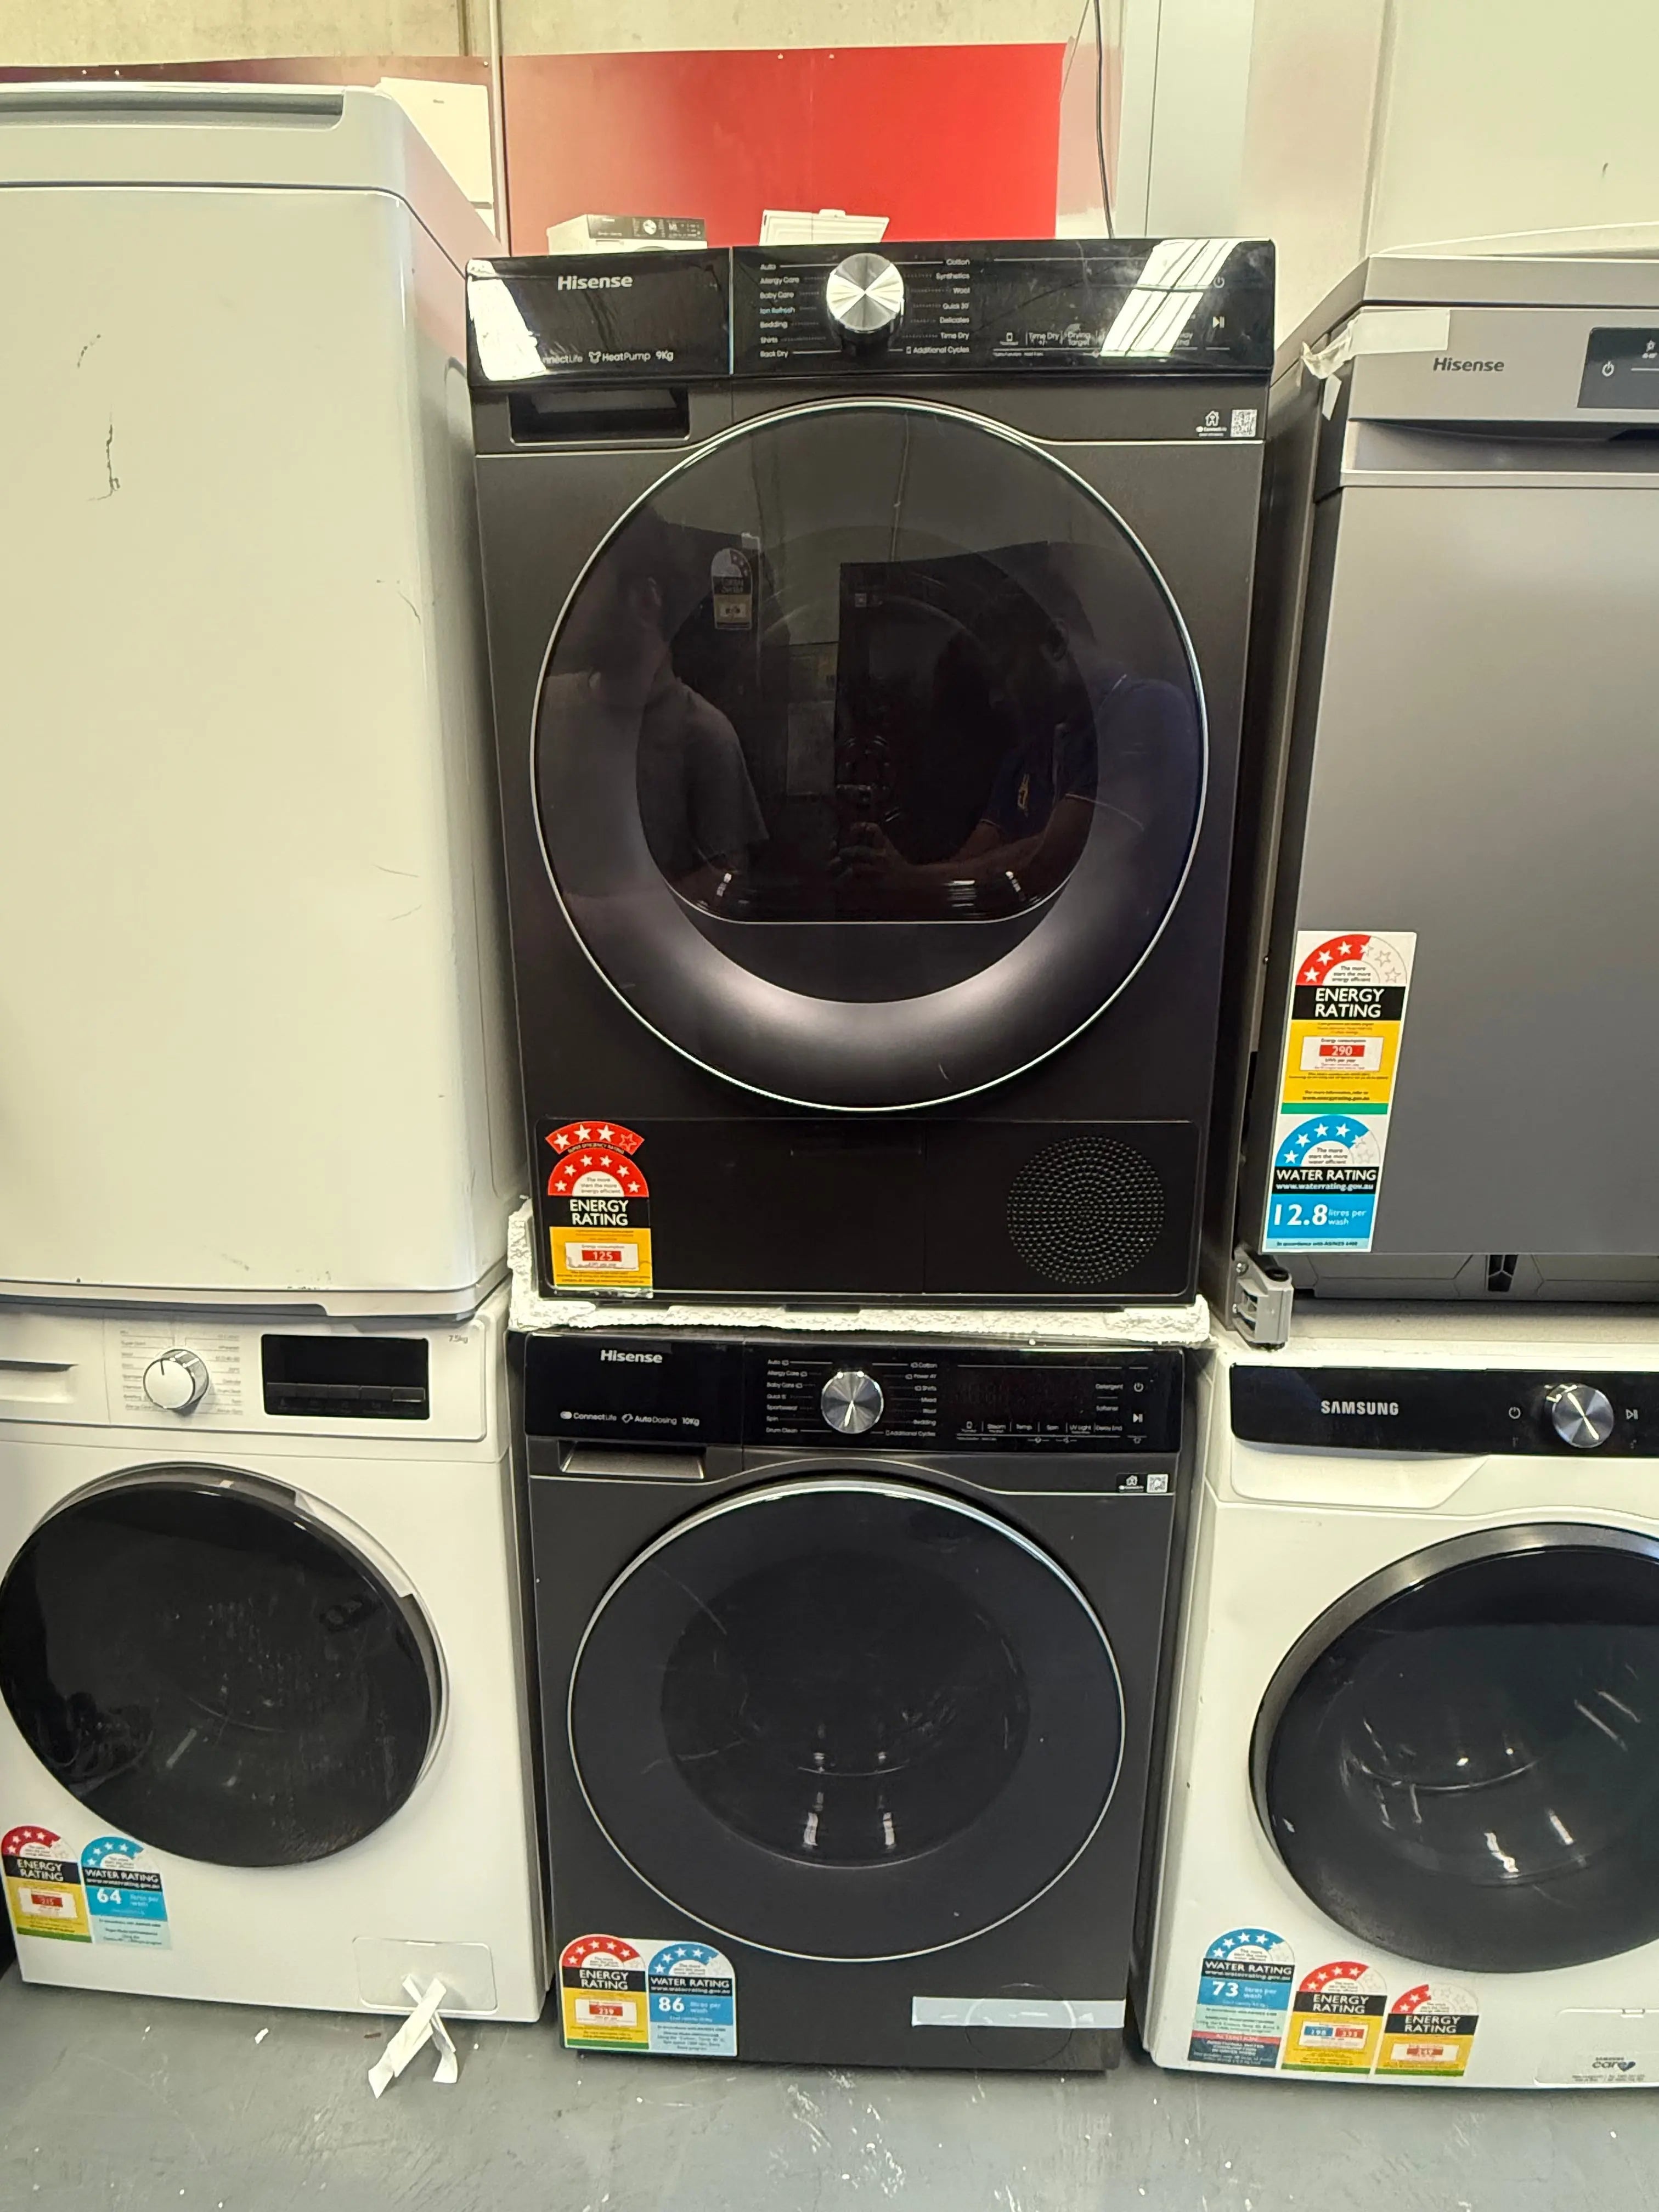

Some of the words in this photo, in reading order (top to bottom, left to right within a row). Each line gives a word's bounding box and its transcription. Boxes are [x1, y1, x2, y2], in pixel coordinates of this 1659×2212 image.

[936, 272, 970, 280] Synthetics
[557, 275, 633, 290] Hisense
[760, 291, 777, 300] Baby
[760, 321, 788, 329] Bedding
[958, 332, 970, 340] Dry
[1047, 332, 1060, 341] Dry
[1068, 332, 1091, 340] Drying
[947, 346, 970, 354] Cycles
[543, 354, 583, 363] nnectLife
[602, 352, 651, 362] HeatPump
[656, 350, 674, 362] 9Kg
[1433, 357, 1504, 372] Hisense
[1315, 988, 1385, 1002] ENERGY
[1314, 1003, 1381, 1018] RATING
[1331, 1046, 1353, 1056] 290
[1276, 1169, 1323, 1181] WATER
[1326, 1170, 1377, 1181] RATING
[1276, 1182, 1374, 1192] www.waterrating.gov.au
[569, 1199, 629, 1212] ENERGY
[1274, 1204, 1328, 1226] 12.8
[1328, 1208, 1350, 1217] litres
[1352, 1210, 1367, 1219] per
[572, 1213, 628, 1226] RATING
[592, 1251, 613, 1261] 125
[600, 1350, 663, 1363] Hisense
[1321, 1400, 1399, 1415] SAMSUNG
[573, 1413, 617, 1421] ConnectLife
[634, 1416, 677, 1425] AutoDosing
[682, 1417, 699, 1426] 10Kg
[17, 1859, 62, 1872] ENERGY
[20, 1869, 64, 1882] RATING
[85, 1869, 120, 1879] WATER
[121, 1872, 159, 1883] RATING
[97, 1887, 122, 1904] 64
[1205, 1961, 1245, 1972] WATER
[1248, 1964, 1292, 1975] RATING
[579, 1970, 629, 1981] ENERGY
[1205, 1970, 1291, 1980] www.waterrating.gov.au
[581, 1979, 628, 1990] RATING
[650, 1977, 686, 1986] WATER
[689, 1979, 730, 1988] RATING
[1212, 1980, 1239, 1997] 73
[659, 1996, 685, 2012] 86
[1313, 1994, 1369, 2005] ENERGY
[1313, 2004, 1365, 2014] RATING
[1405, 2015, 1461, 2025] ENERGY
[1404, 2024, 1457, 2033] RATING
